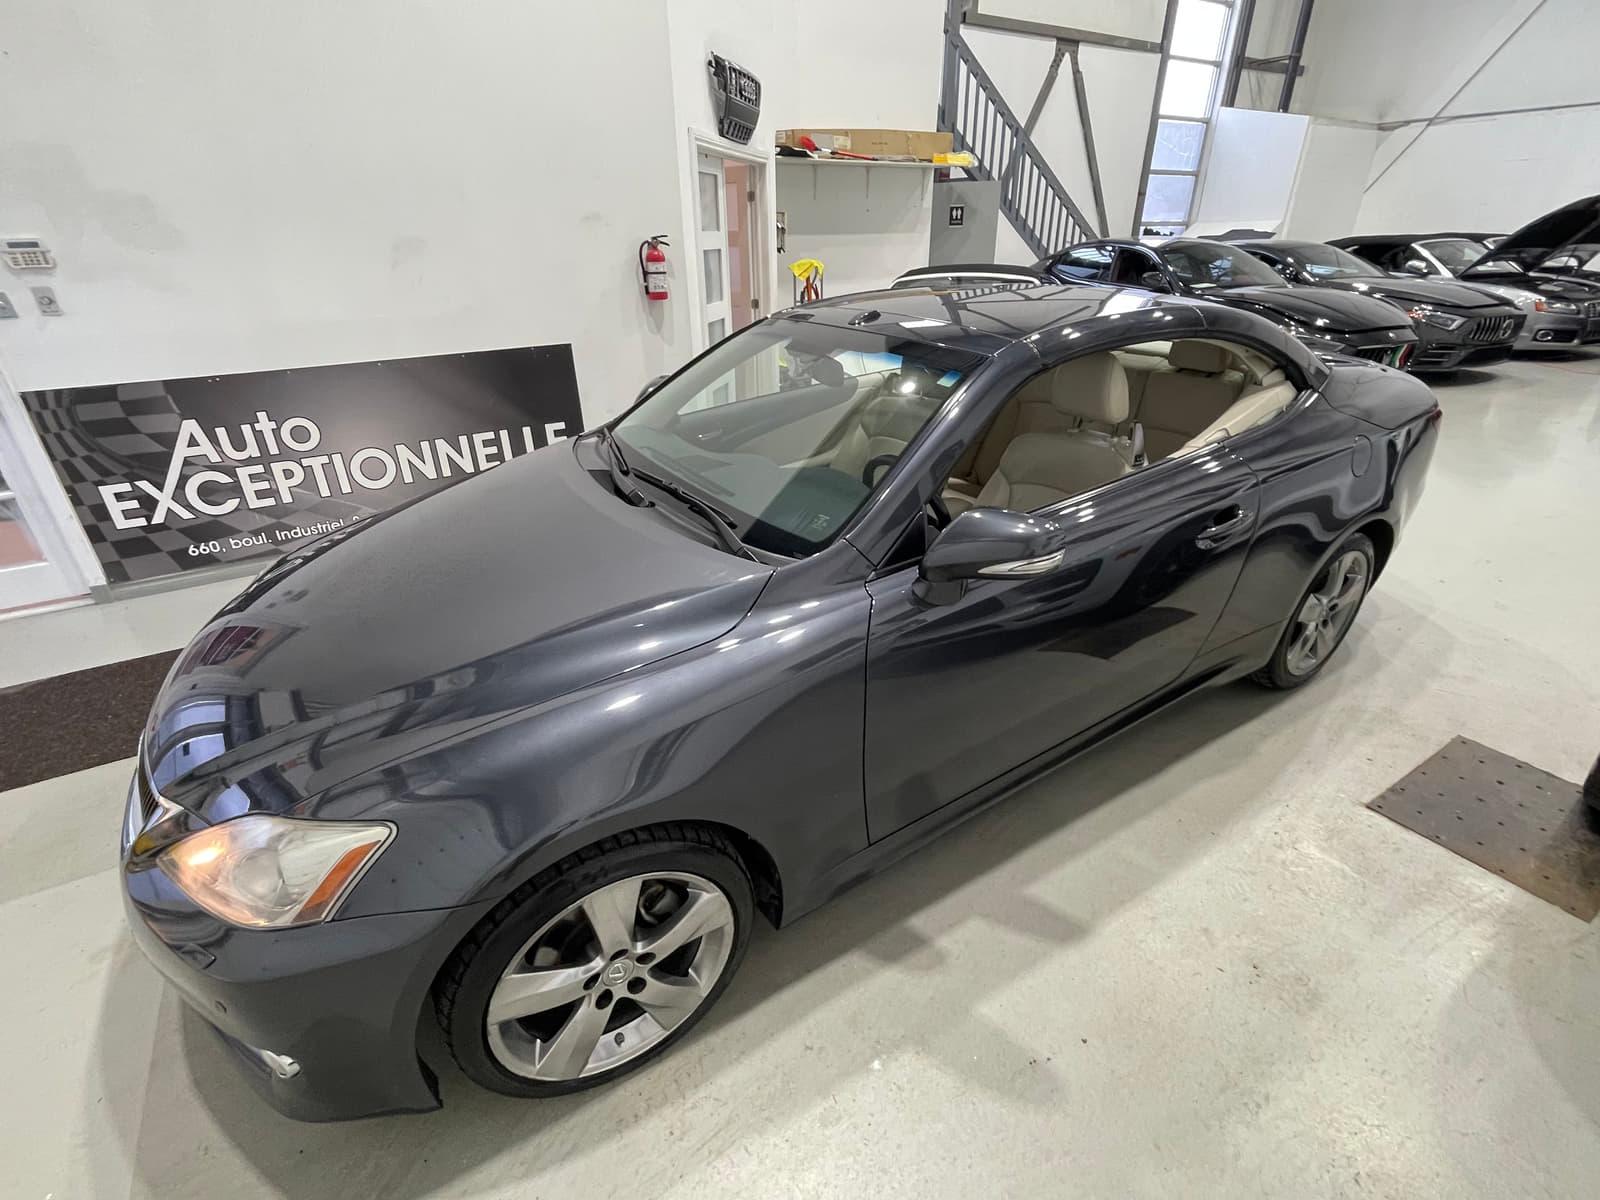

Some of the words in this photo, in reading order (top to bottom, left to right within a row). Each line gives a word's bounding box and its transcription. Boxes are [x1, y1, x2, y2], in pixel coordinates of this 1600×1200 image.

[171, 411, 321, 463] Auto
[188, 541, 226, 556] 660,
[229, 533, 272, 549] boul.
